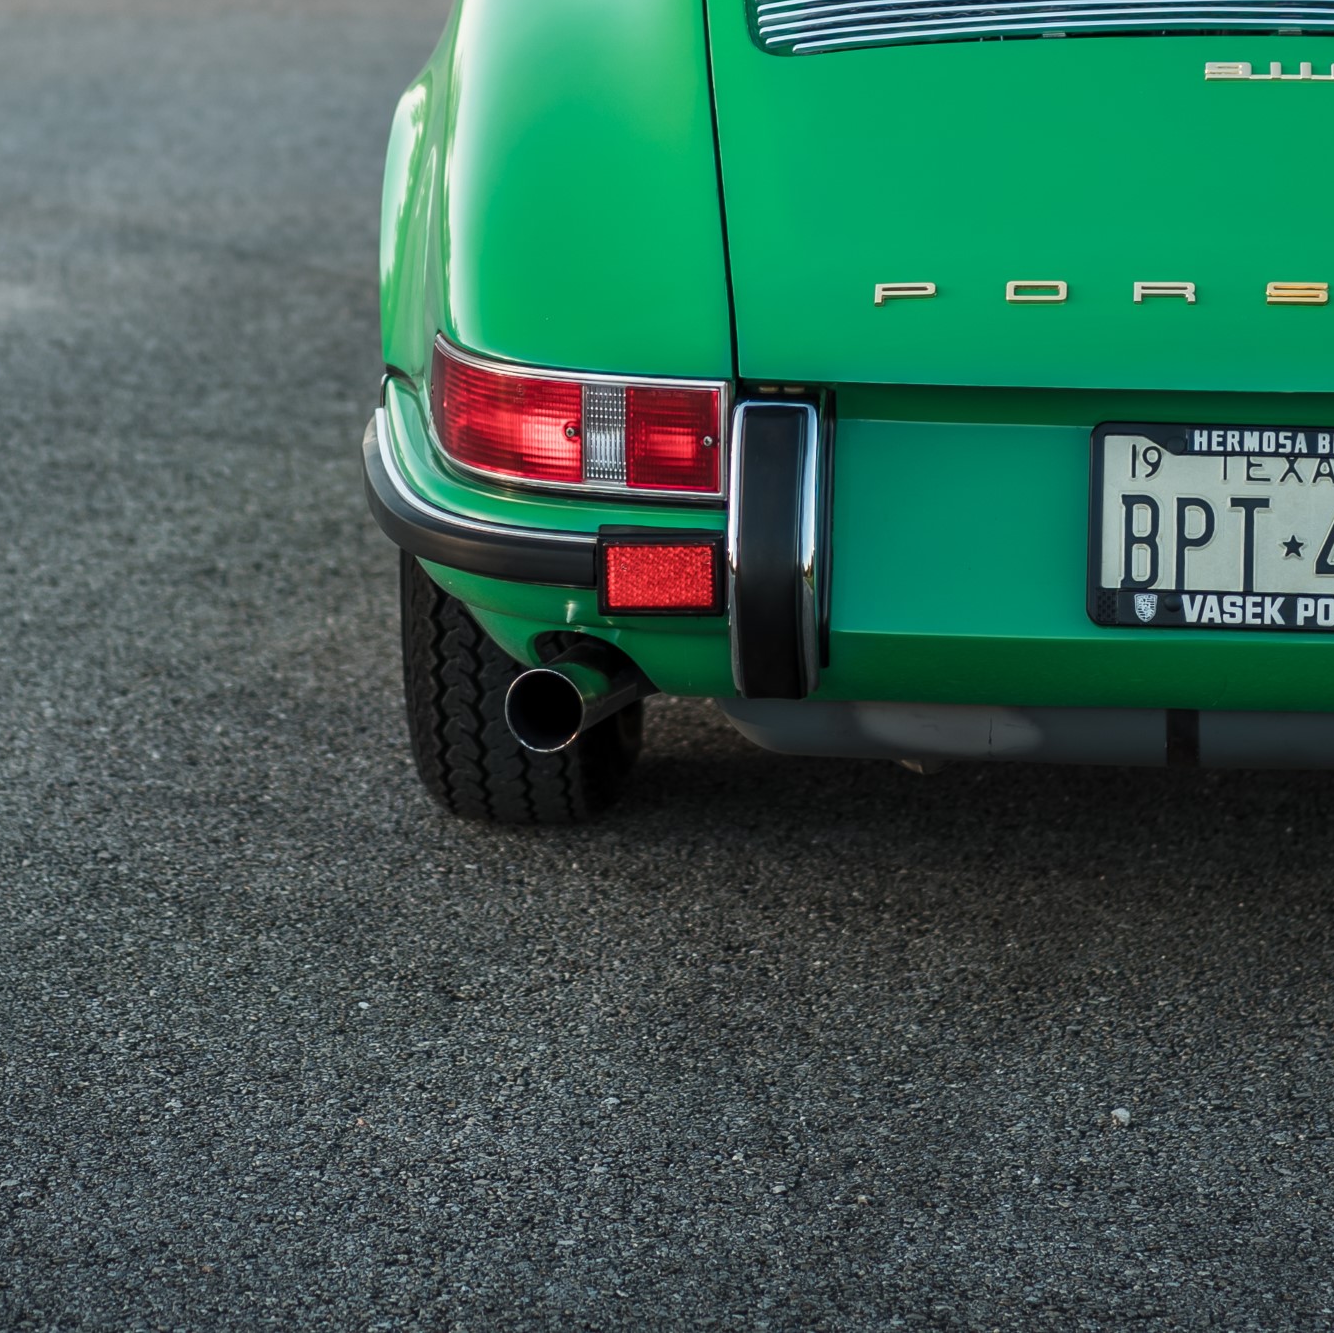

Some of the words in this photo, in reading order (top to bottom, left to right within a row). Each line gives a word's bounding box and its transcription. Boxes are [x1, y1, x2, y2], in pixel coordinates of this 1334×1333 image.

[1193, 430, 1309, 455] HERMOSA
[1131, 443, 1163, 479] 19
[1181, 594, 1286, 626] VASEK
